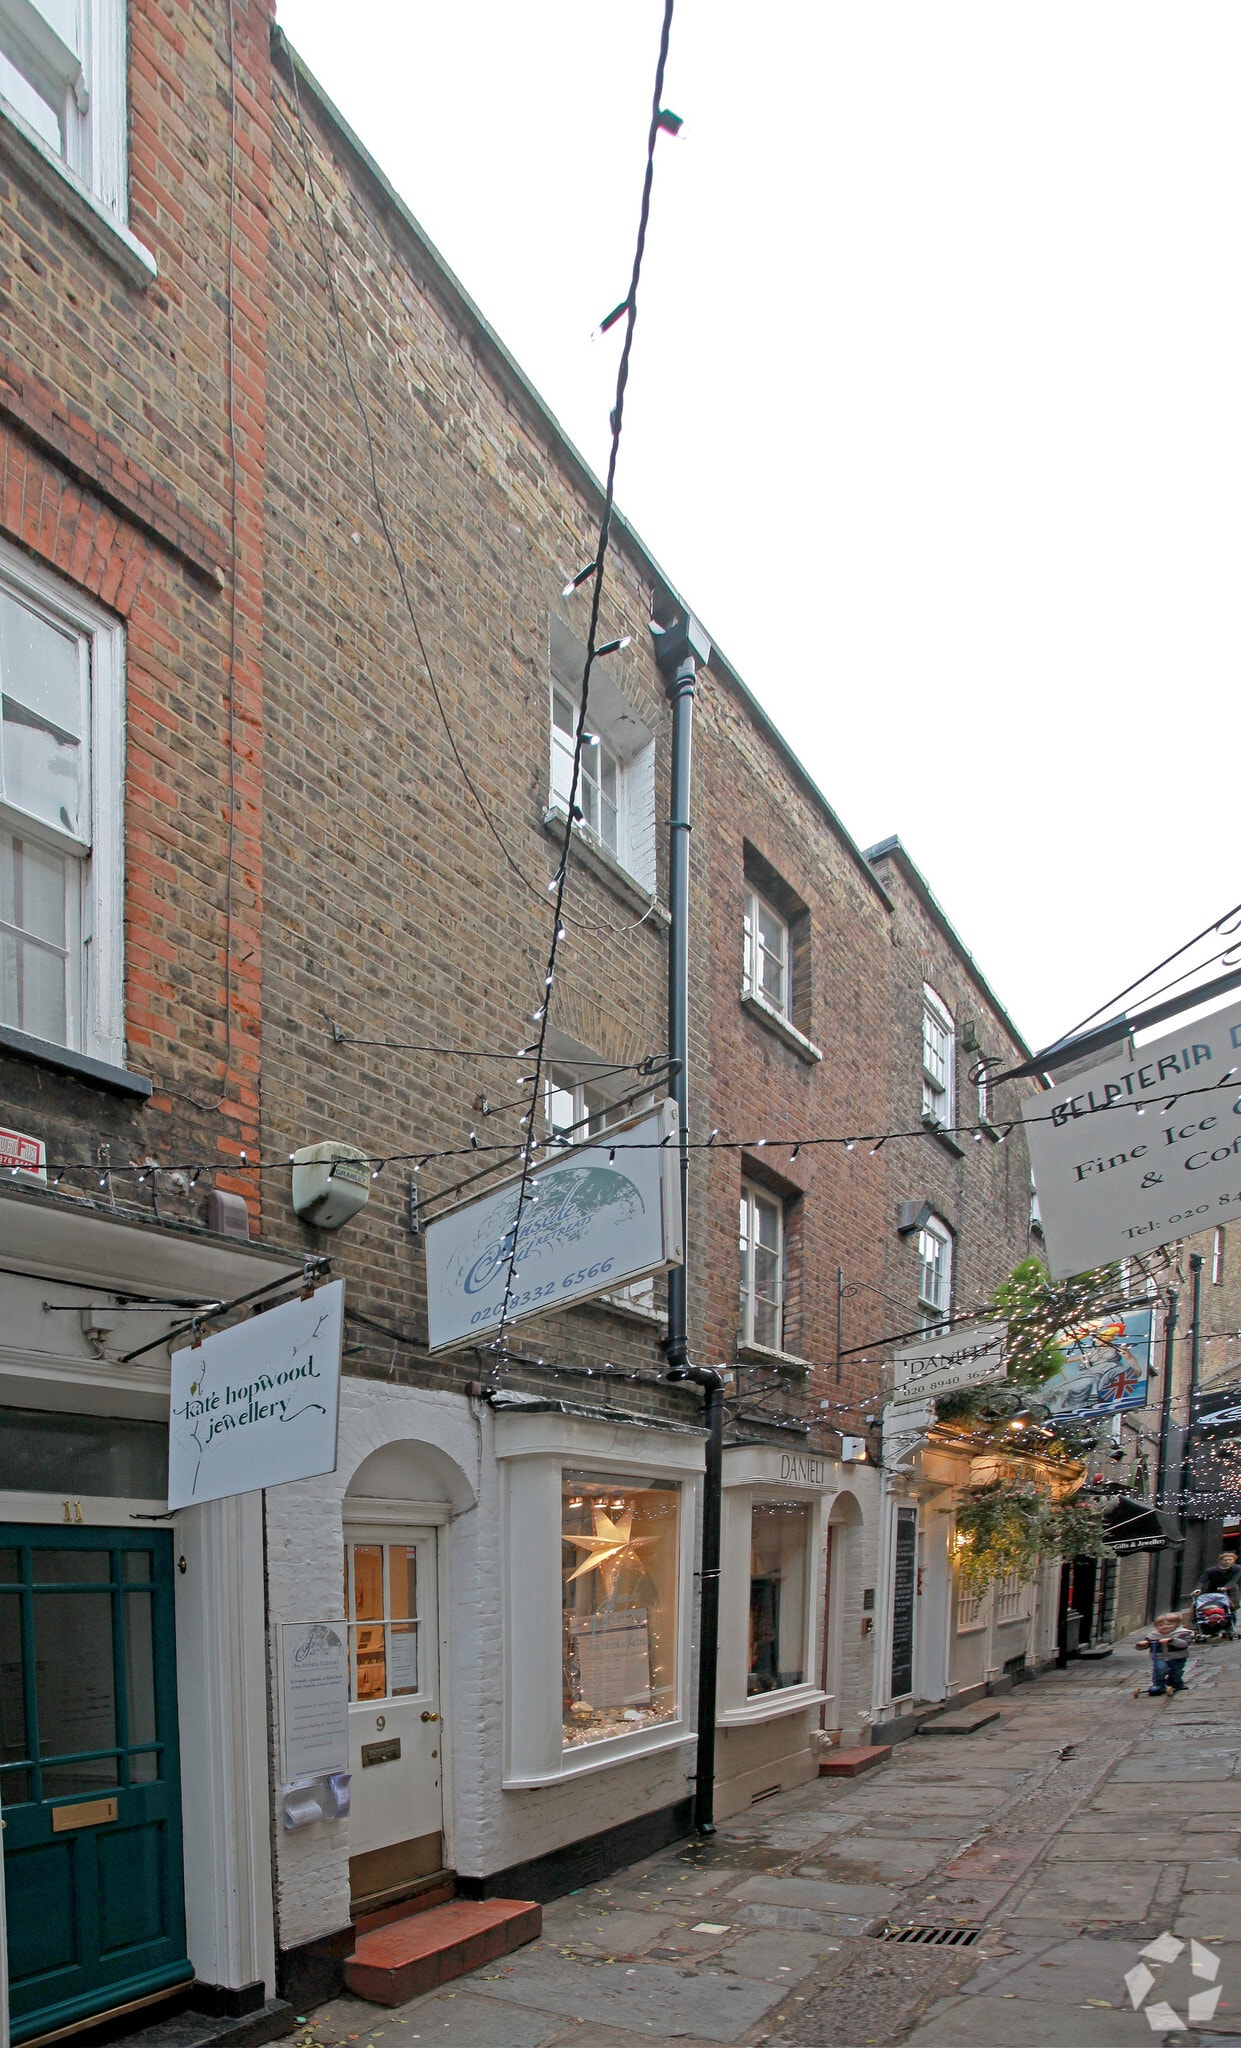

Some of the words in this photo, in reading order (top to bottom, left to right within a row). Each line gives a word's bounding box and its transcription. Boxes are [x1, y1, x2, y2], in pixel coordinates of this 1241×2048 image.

[1073, 1144, 1148, 1183] Fine
[1162, 1116, 1218, 1147] Ice
[1140, 1171, 1164, 1189] &
[535, 1211, 595, 1247] RETREATS
[1121, 1220, 1160, 1240] Tel:
[1168, 1204, 1210, 1225] 020
[470, 1302, 505, 1325] 020
[509, 1281, 555, 1310] 8332
[562, 1257, 615, 1288] 6566
[173, 1392, 220, 1420] kate
[226, 1355, 321, 1405] hopwood
[903, 1385, 925, 1397] 020
[930, 1376, 960, 1390] 8940
[205, 1397, 327, 1444] jewellery
[781, 1454, 824, 1484] DANIELI
[63, 1500, 83, 1522] 11
[1114, 1542, 1129, 1551] Gifts
[1130, 1541, 1136, 1549] &
[1137, 1539, 1166, 1548] Jewellery
[376, 1715, 386, 1732] 9
